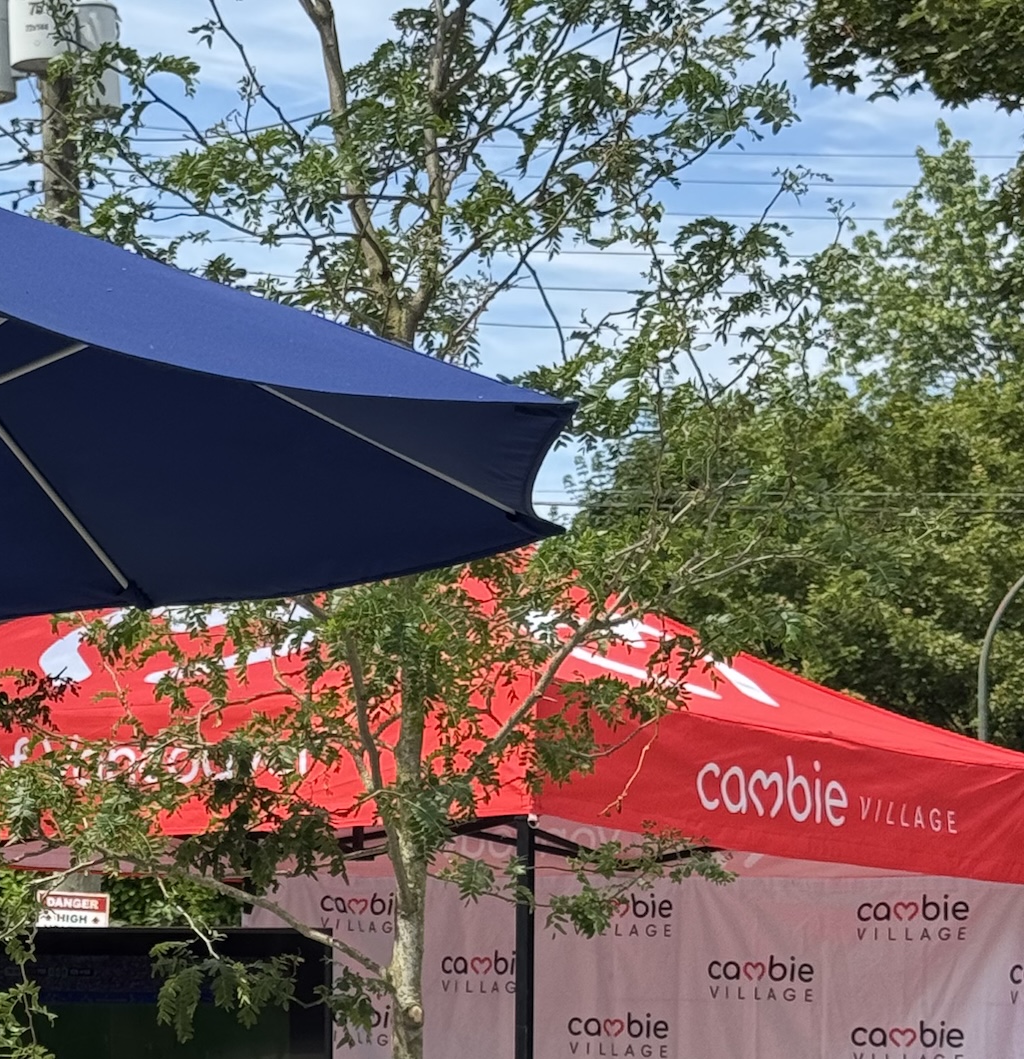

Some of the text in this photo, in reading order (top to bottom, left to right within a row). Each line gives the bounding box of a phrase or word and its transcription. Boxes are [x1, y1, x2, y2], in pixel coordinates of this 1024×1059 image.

[696, 755, 958, 834] cambie VILLAGE
[46, 896, 99, 910] DANGER
[320, 892, 395, 916] cambi
[857, 895, 969, 922] cambie
[57, 913, 87, 924] HIGH
[321, 917, 393, 933] VILLAG
[857, 926, 966, 941] VILLAGE
[441, 949, 516, 976] cambi
[708, 955, 814, 982] cambie
[442, 980, 516, 994] VILLAG
[709, 985, 813, 1002] VILLAGE
[568, 1013, 669, 1039] cambie
[851, 1021, 964, 1048] cambie
[570, 1042, 668, 1059] VILLAGE
